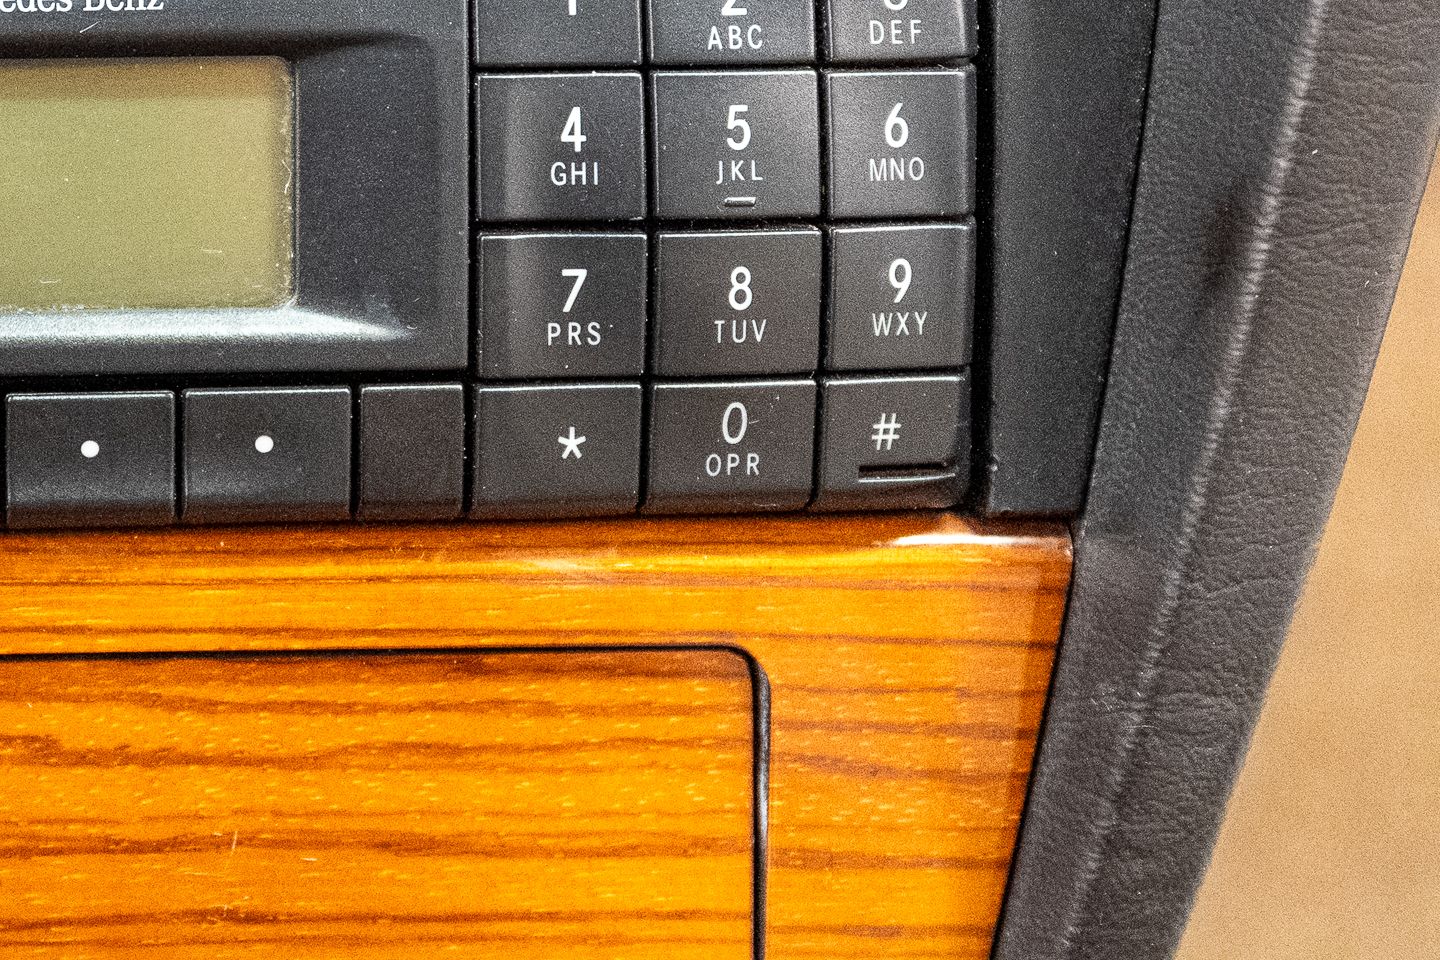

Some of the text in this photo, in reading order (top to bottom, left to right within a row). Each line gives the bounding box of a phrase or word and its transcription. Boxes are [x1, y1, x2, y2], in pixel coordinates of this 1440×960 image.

[707, 25, 763, 51] ABC
[869, 19, 922, 46] DEF
[560, 106, 587, 153] 4
[726, 104, 752, 150] 5
[884, 102, 909, 148] 6
[550, 162, 600, 187] GHI
[716, 160, 764, 185] JKL
[869, 157, 925, 182] MNO
[561, 268, 588, 313] 7
[728, 266, 753, 311] 8
[888, 258, 912, 303] 9
[547, 322, 601, 346] PRS
[714, 319, 767, 344] TUV
[871, 311, 927, 337] WXY
[722, 402, 748, 445] 0
[705, 453, 760, 477] OPR
